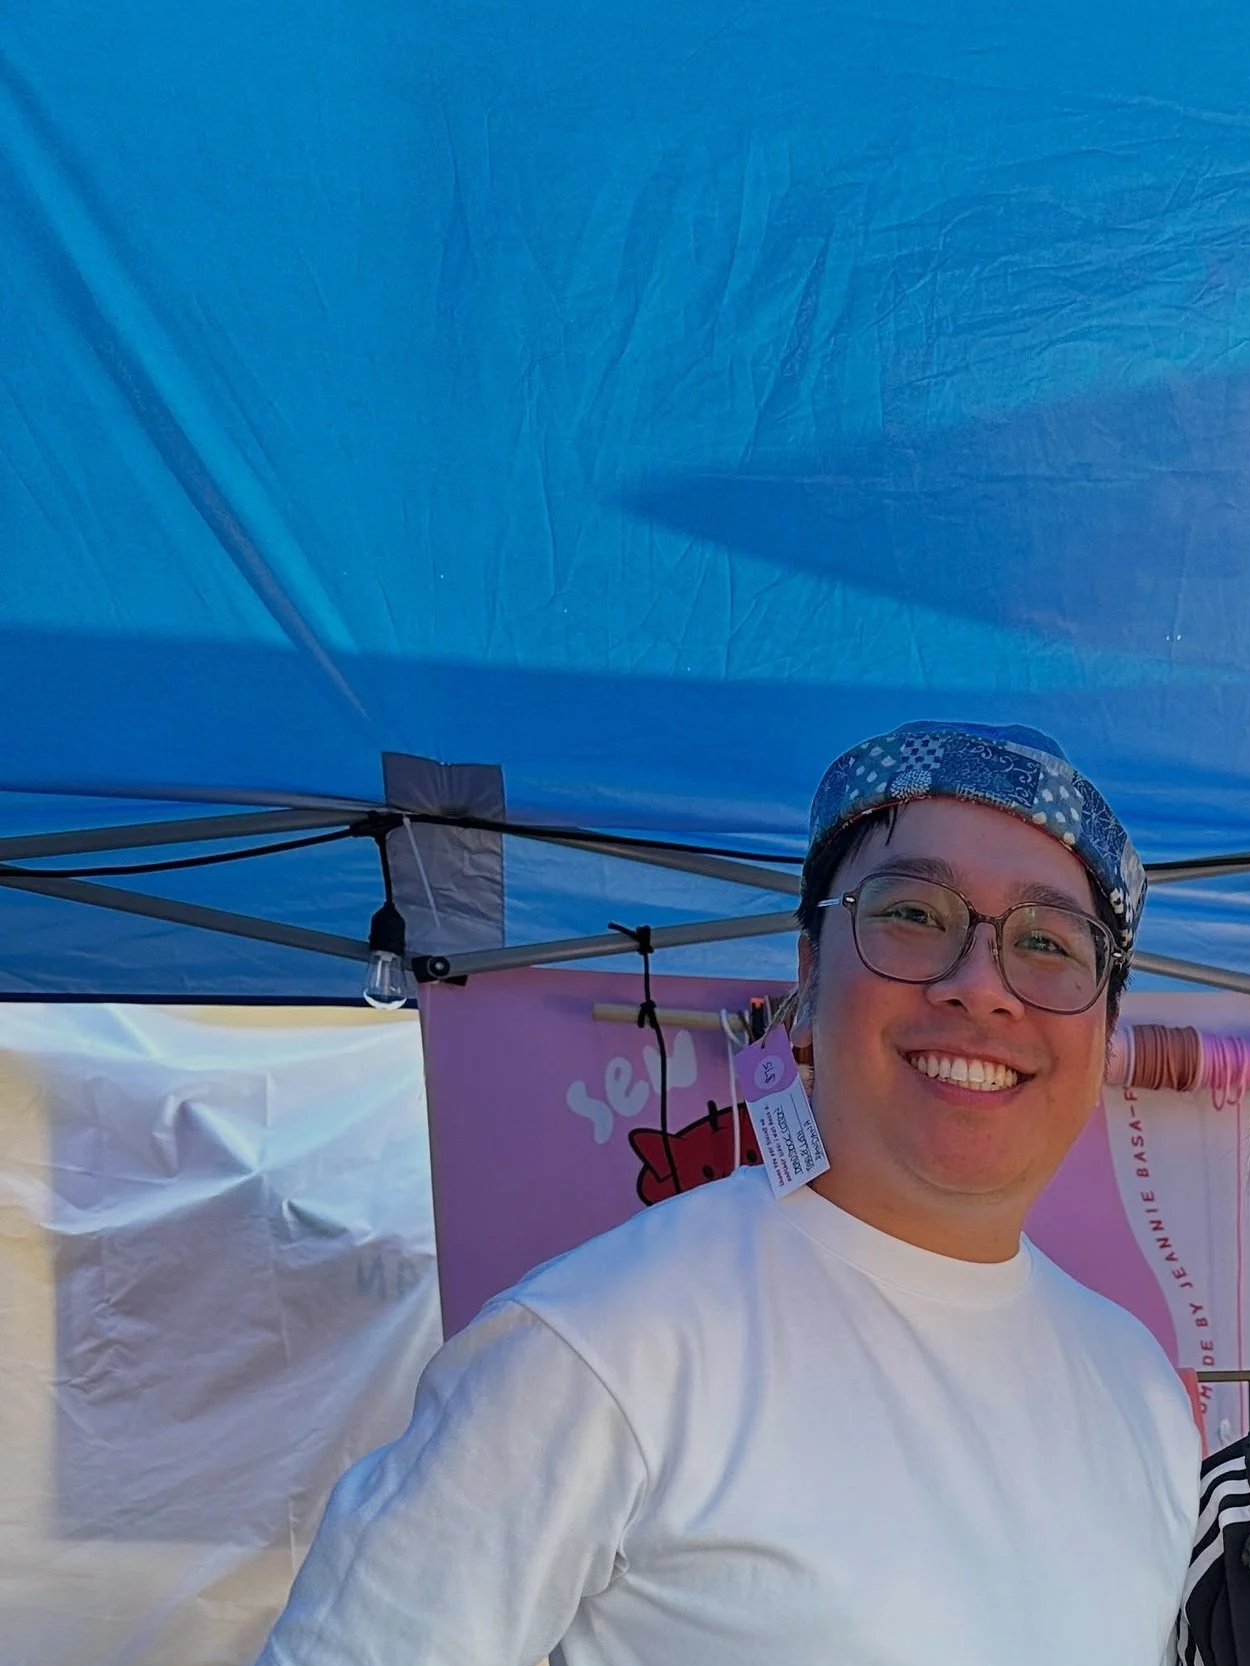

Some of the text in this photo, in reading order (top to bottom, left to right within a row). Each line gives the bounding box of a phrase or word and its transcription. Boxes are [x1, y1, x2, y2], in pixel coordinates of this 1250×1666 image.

[567, 1030, 698, 1144] sew
[1124, 1086, 1149, 1177] BASA-F
[1141, 1190, 1193, 1288] JEANNIE
[1189, 1303, 1208, 1327] BY
